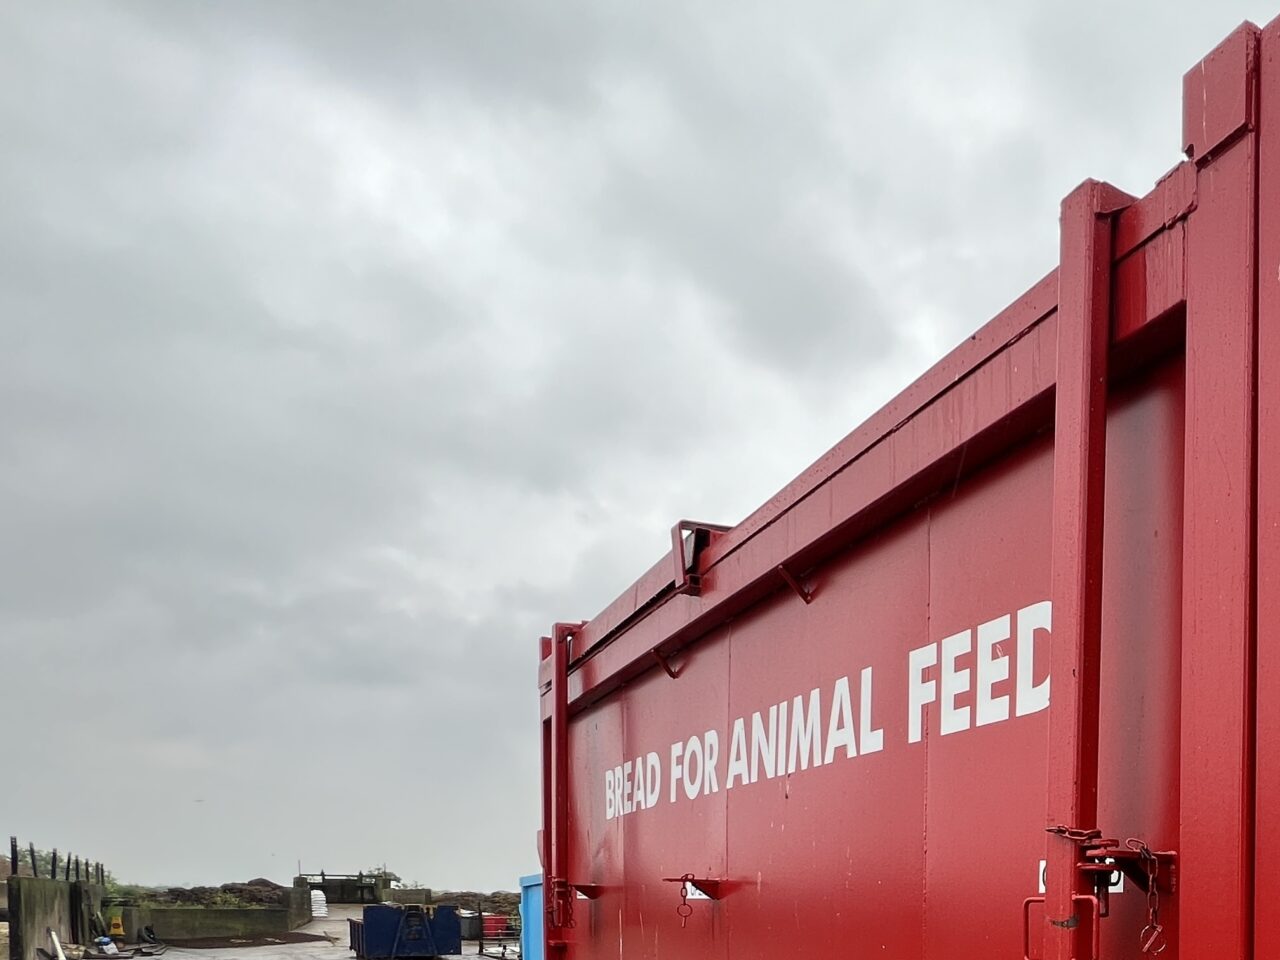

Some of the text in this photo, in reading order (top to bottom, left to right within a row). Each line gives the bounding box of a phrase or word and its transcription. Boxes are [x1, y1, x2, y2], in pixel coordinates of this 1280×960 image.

[605, 751, 661, 821] BREAD
[670, 729, 719, 803] FOR
[726, 666, 884, 789] ANIMAL
